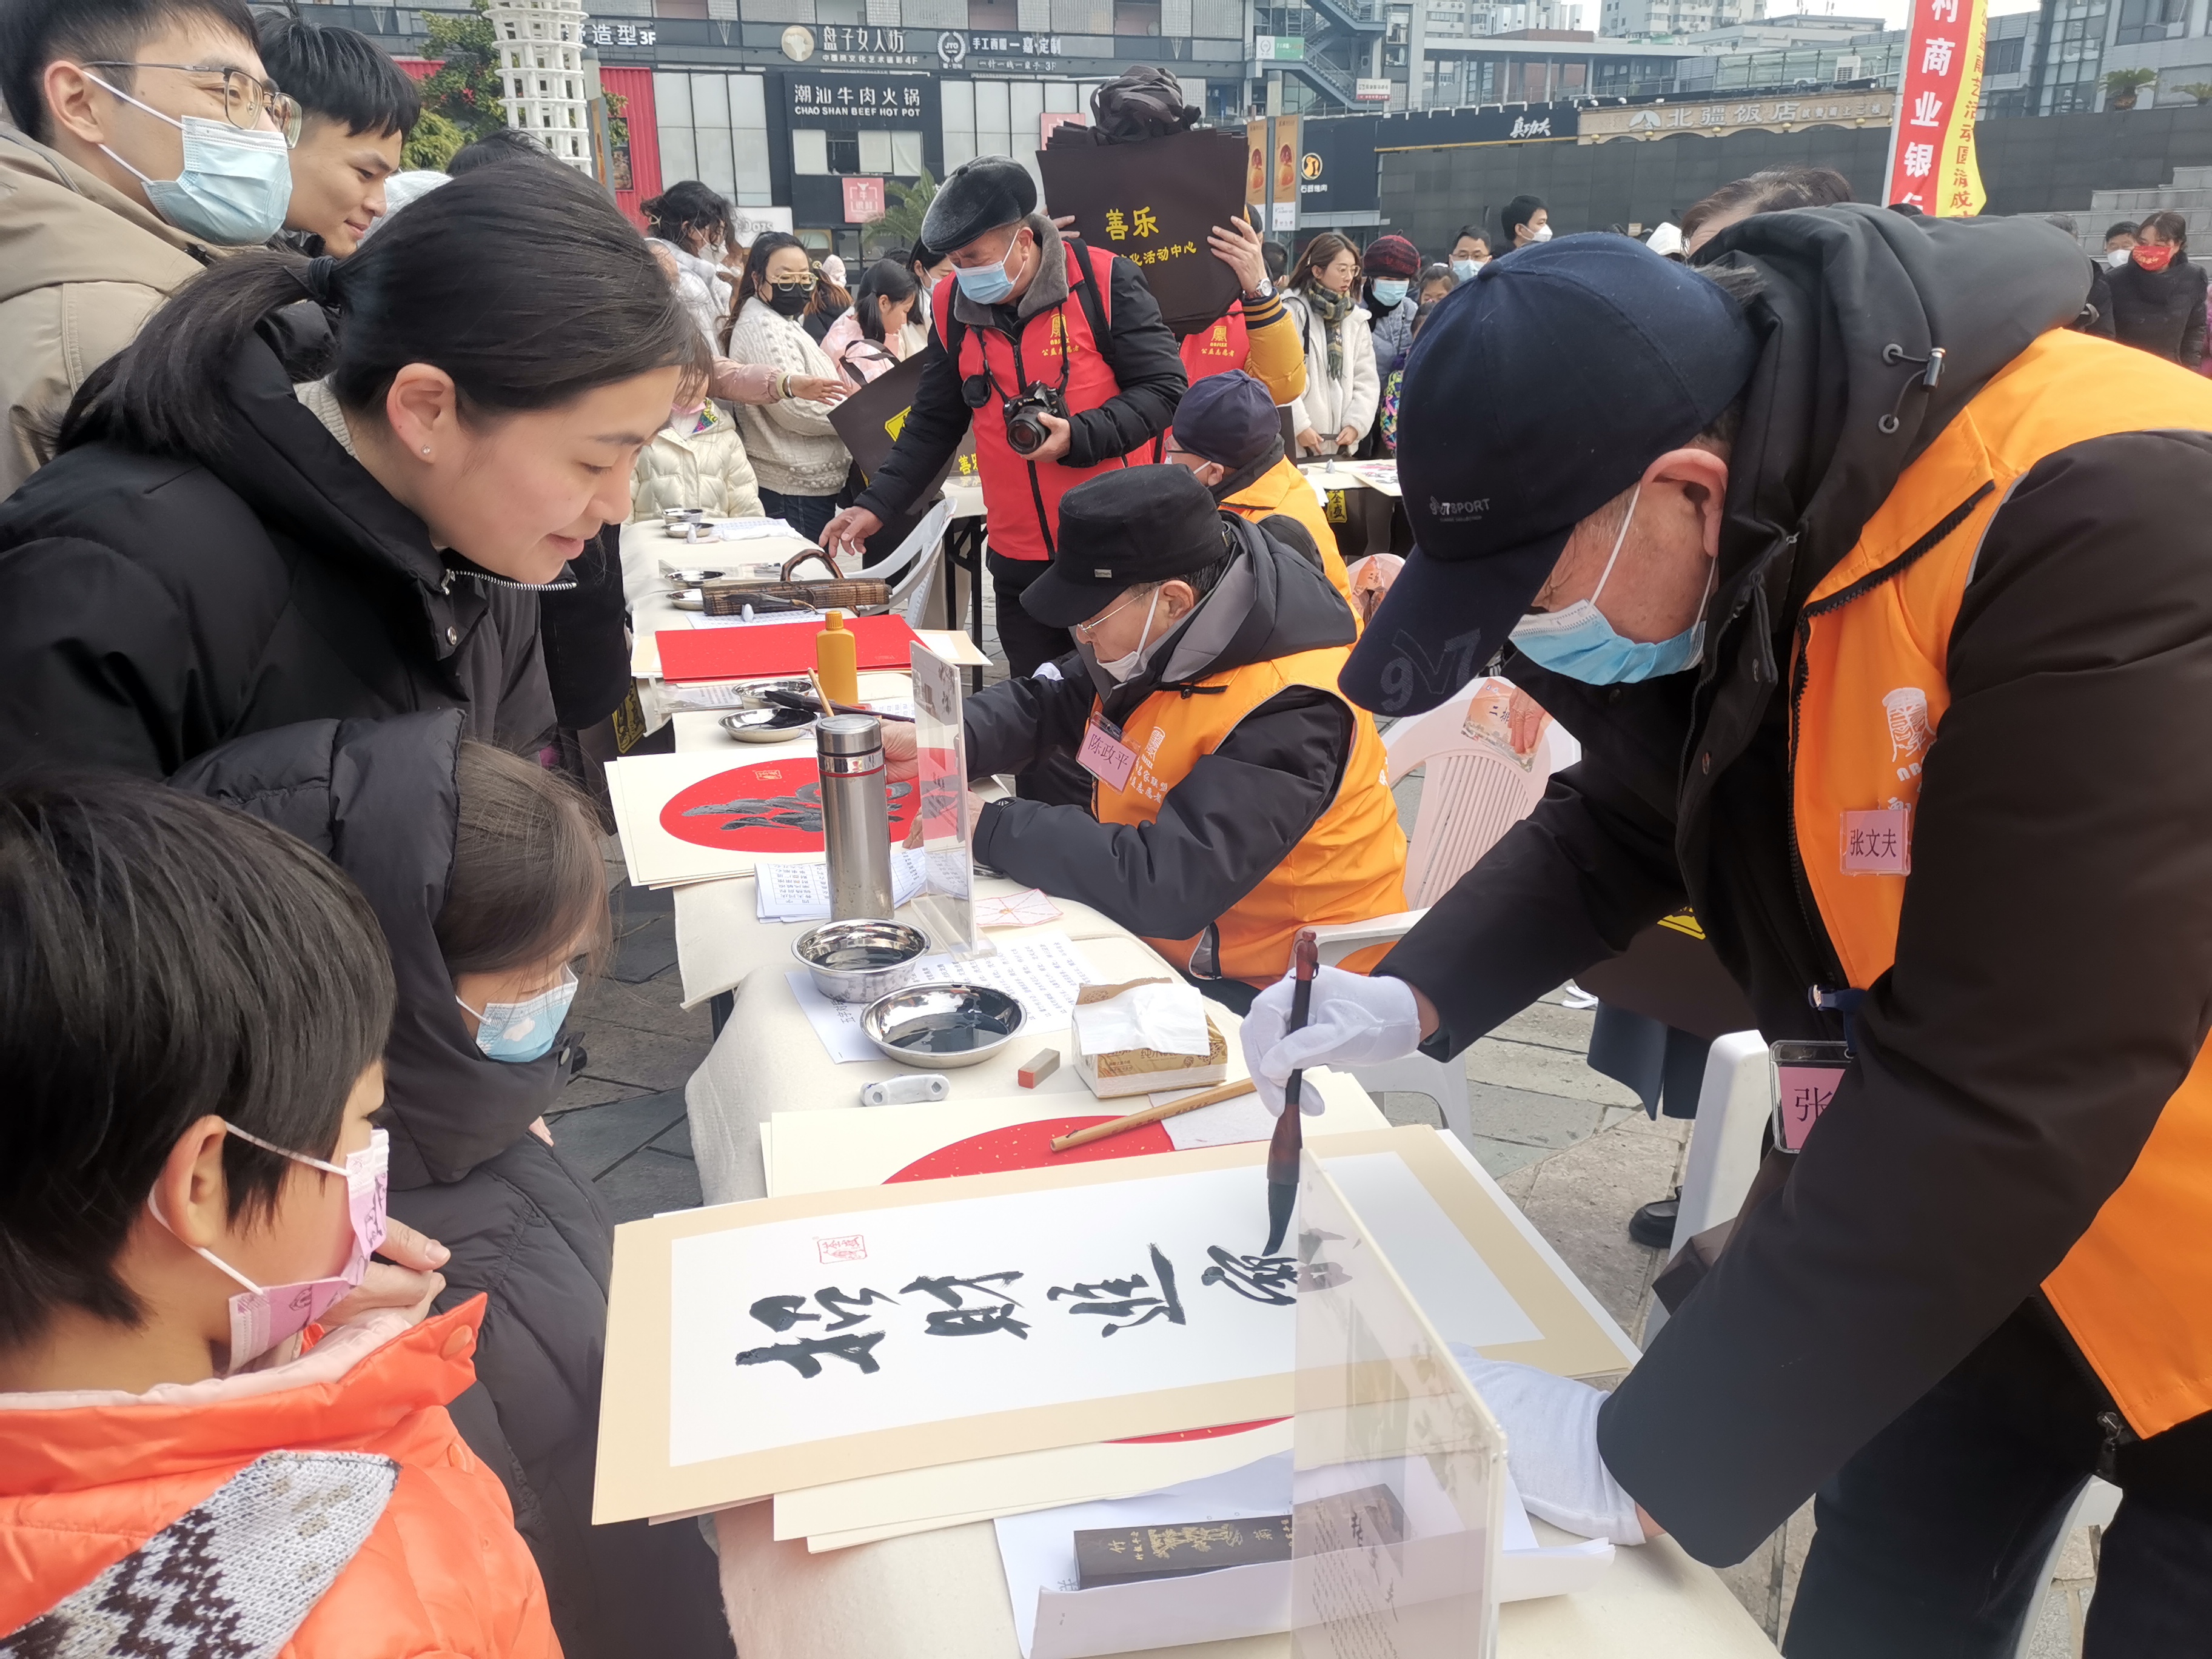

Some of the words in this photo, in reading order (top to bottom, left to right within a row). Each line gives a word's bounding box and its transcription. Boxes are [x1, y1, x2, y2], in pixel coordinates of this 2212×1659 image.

[794, 84, 920, 107] 潮汕牛肉火锅
[794, 106, 820, 115] CHAO
[822, 106, 848, 116] SHAN
[851, 107, 877, 116] BEEF
[879, 108, 899, 117] HOT
[902, 108, 921, 117] POT
[1668, 101, 1800, 127] 北疆饭店
[1105, 206, 1159, 241] 善乐
[1121, 241, 1197, 266] 化活动中心
[1088, 734, 1129, 770] 陈政平
[1849, 828, 1897, 858] 张文夫
[1794, 1087, 1833, 1122] 张
